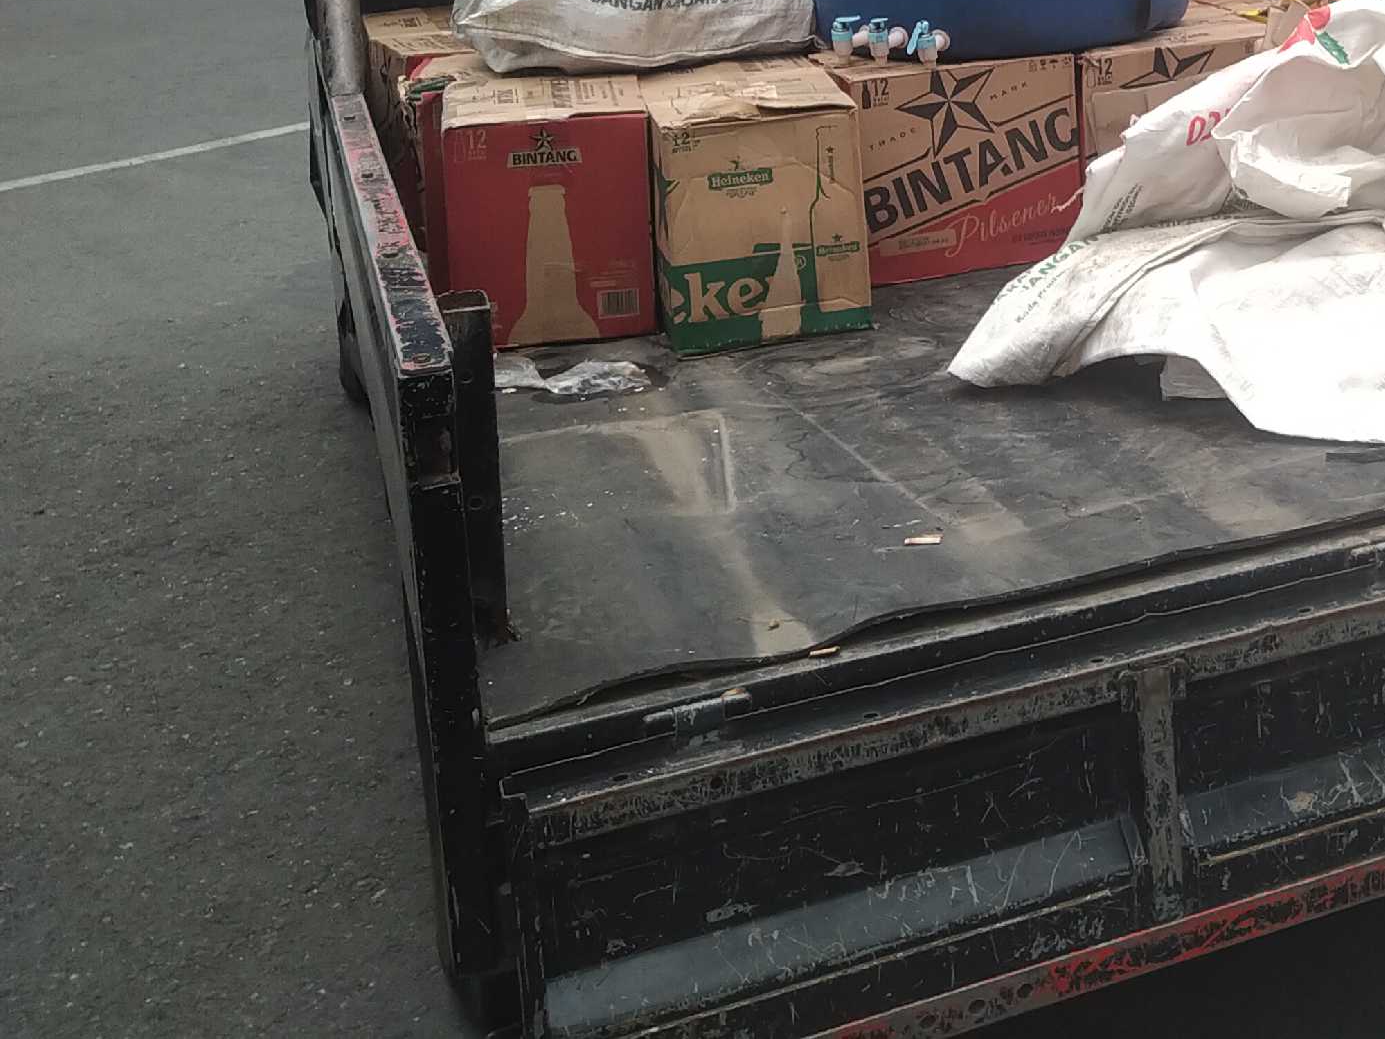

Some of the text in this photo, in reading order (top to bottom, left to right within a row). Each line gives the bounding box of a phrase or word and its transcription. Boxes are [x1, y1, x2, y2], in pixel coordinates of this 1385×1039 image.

[467, 129, 488, 149] 12
[511, 148, 578, 167] BINTANG
[711, 170, 770, 188] Heineken
[864, 107, 1080, 234] BINTANG
